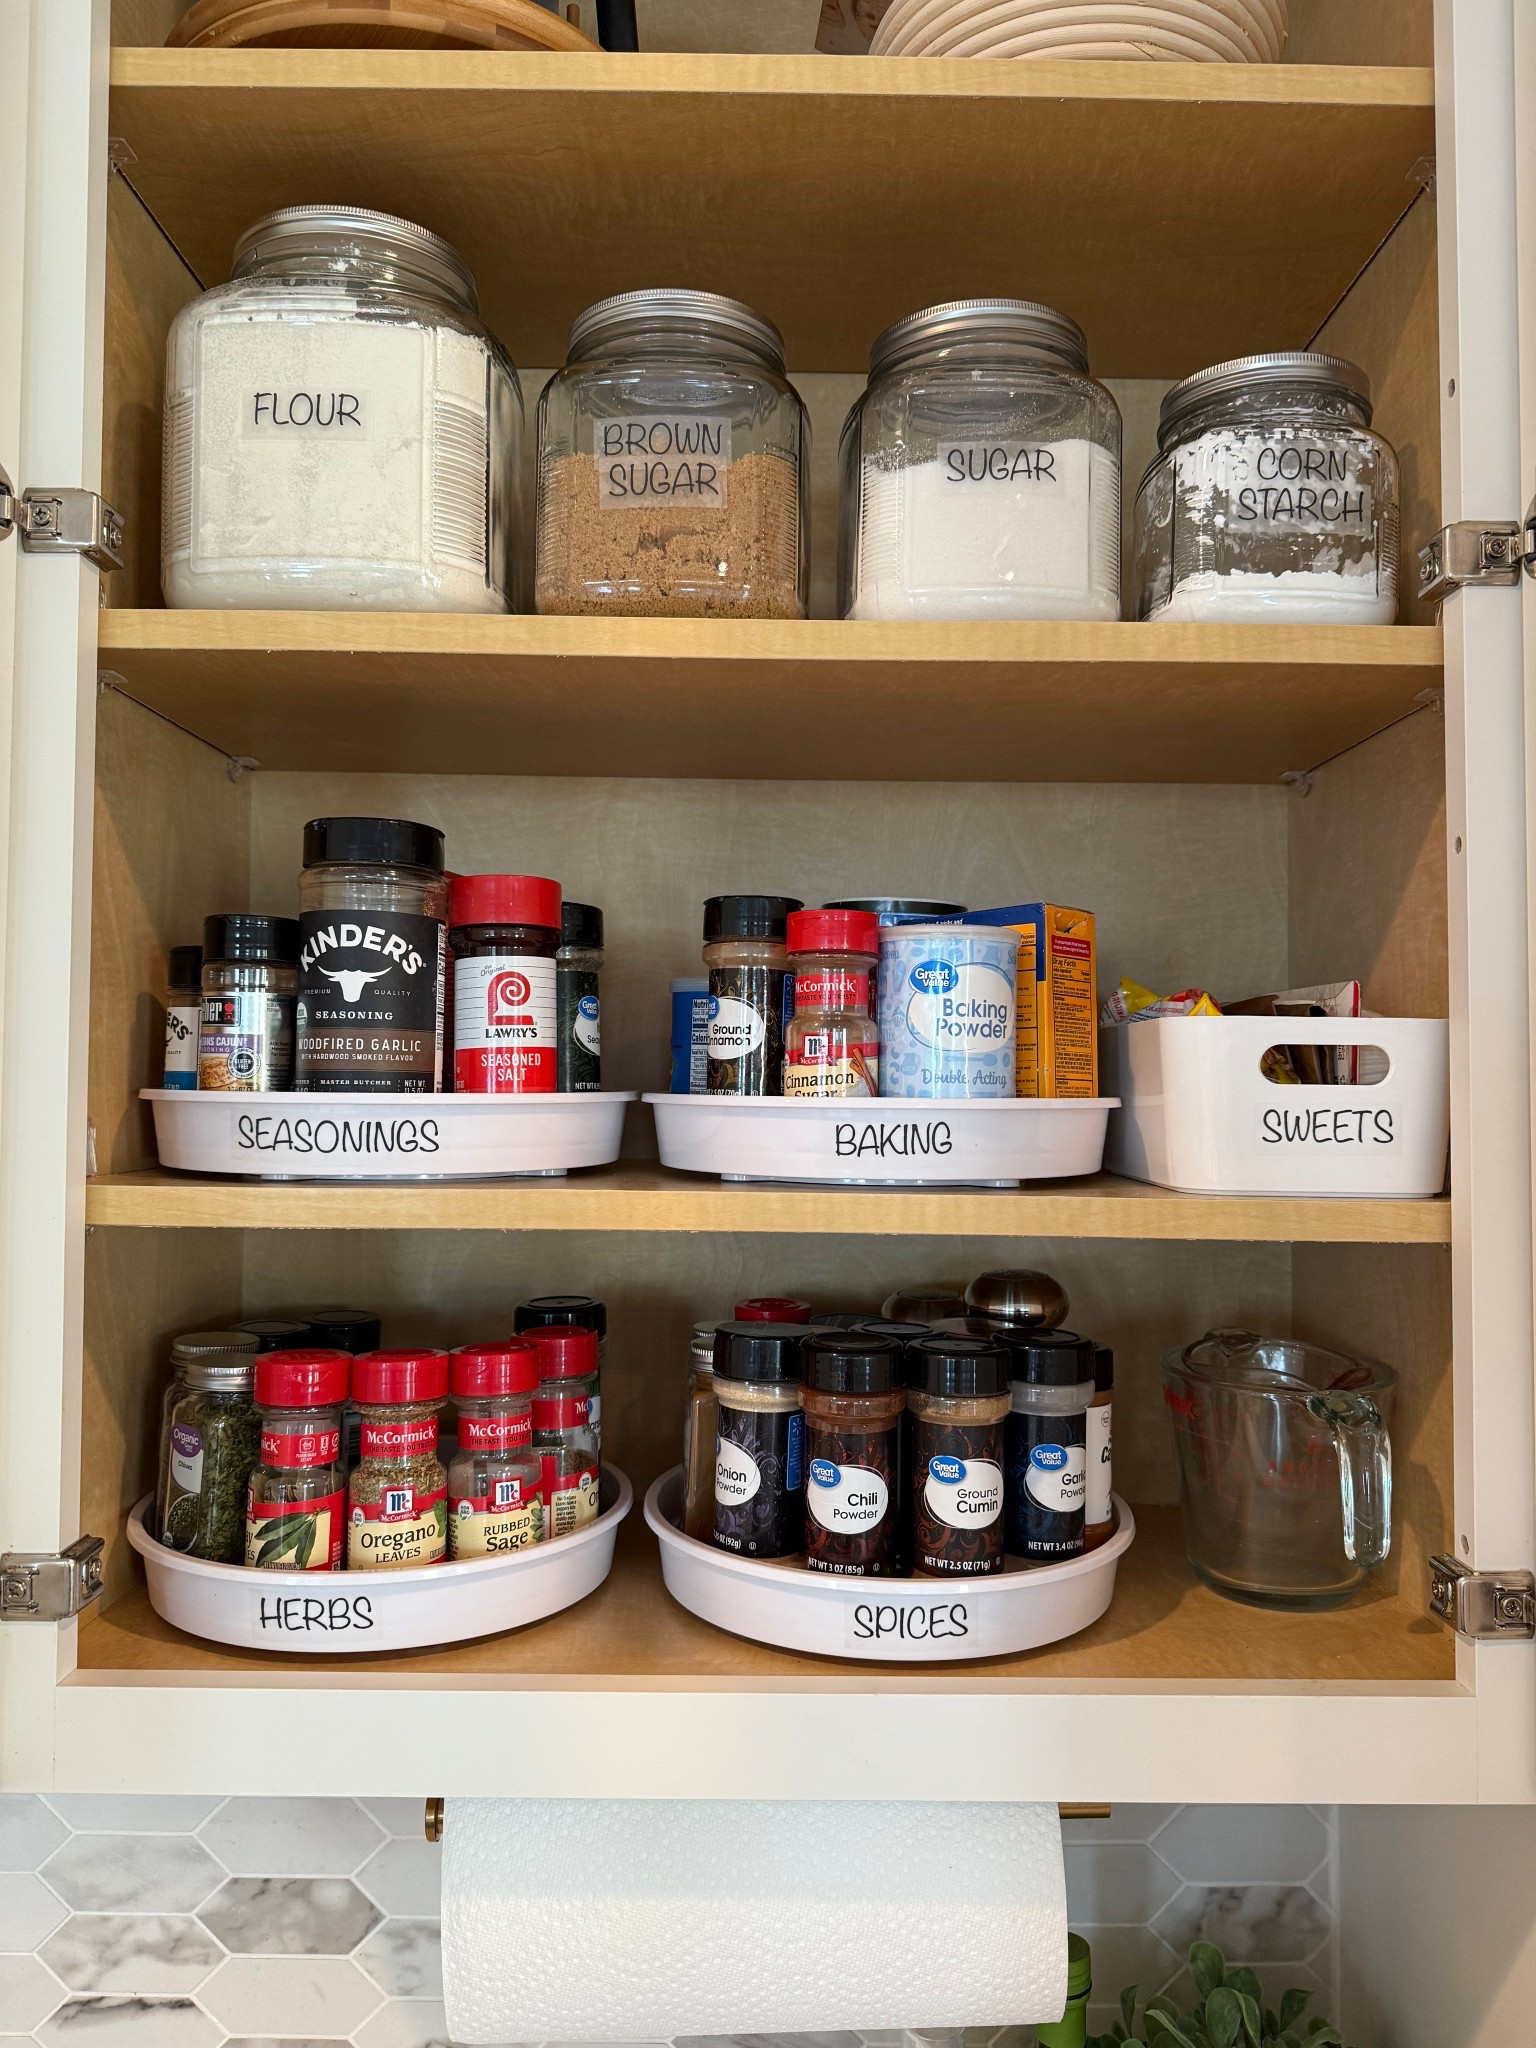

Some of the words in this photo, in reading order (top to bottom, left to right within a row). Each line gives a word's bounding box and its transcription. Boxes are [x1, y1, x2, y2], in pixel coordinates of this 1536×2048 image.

[254, 392, 361, 426] FLOUR
[603, 422, 723, 456] BROWN
[946, 447, 1057, 482] SUGAR
[1257, 447, 1349, 481] CORN
[608, 461, 719, 497] SUGAR
[1238, 487, 1364, 522] STARCH
[300, 923, 423, 975] KINDER'S
[1063, 959, 1077, 967] Facts
[480, 964, 506, 977] Original
[915, 968, 950, 980] Great
[923, 978, 950, 987] Value
[374, 989, 411, 997] QUALITY
[315, 1010, 393, 1020] SEASONING
[943, 998, 1007, 1024] Baking
[167, 1011, 190, 1040] ER'S
[712, 1024, 751, 1035] Ground
[936, 1018, 1007, 1039] Powder
[485, 1028, 538, 1039] LAWRY'S
[691, 1034, 708, 1043] Calori
[708, 1035, 751, 1046] innamon
[371, 1038, 421, 1052] GARLIC
[351, 1053, 383, 1061] SMOKED
[385, 1053, 414, 1062] FLAVOR
[481, 1053, 541, 1067] SEASONED
[497, 1067, 527, 1081] SALT
[786, 1072, 855, 1089] Cinnamon
[921, 1069, 968, 1085] Double
[973, 1070, 1007, 1088] Acting
[404, 1079, 417, 1088] NET
[1261, 1109, 1394, 1143] SWEETS
[238, 1115, 440, 1153] SEASONINGS
[835, 1121, 952, 1157] BAKING
[366, 1425, 436, 1444] McCormick
[468, 1418, 531, 1437] McCormick
[173, 1428, 199, 1446] Organic
[369, 1445, 379, 1453] THE
[380, 1445, 401, 1453] TASTE
[1035, 1450, 1062, 1459] Great
[717, 1463, 747, 1482] Onion
[812, 1463, 834, 1477] Great
[933, 1460, 960, 1473] Great
[816, 1473, 834, 1483] Value
[939, 1471, 960, 1479] Value
[716, 1477, 747, 1496] Powder
[957, 1487, 998, 1499] Ground
[1060, 1485, 1085, 1498] Powde
[490, 1500, 525, 1513] McCormick
[847, 1492, 878, 1507] Chili
[956, 1499, 998, 1513] Cumin
[380, 1509, 418, 1522] McCormick
[833, 1508, 879, 1520] Powder
[483, 1516, 530, 1537] RUBBED
[361, 1524, 436, 1550] Oregano
[486, 1531, 529, 1553] Sage
[726, 1536, 742, 1549] (92g)
[1028, 1541, 1042, 1550] NET
[1042, 1542, 1055, 1551] WT
[1055, 1541, 1066, 1551] 3.4
[1066, 1540, 1074, 1549] OZ
[375, 1547, 421, 1564] LEAVES
[818, 1560, 828, 1571] WT
[828, 1563, 833, 1572] 3
[834, 1564, 844, 1572] OZ
[844, 1564, 865, 1575] (85g)
[924, 1555, 936, 1565] NET
[936, 1558, 949, 1569] WT
[949, 1560, 961, 1570] 2.5
[962, 1561, 973, 1570] OZ
[973, 1559, 991, 1571] (71g)
[260, 1596, 374, 1631] HERBS
[853, 1603, 969, 1640] SPICES
